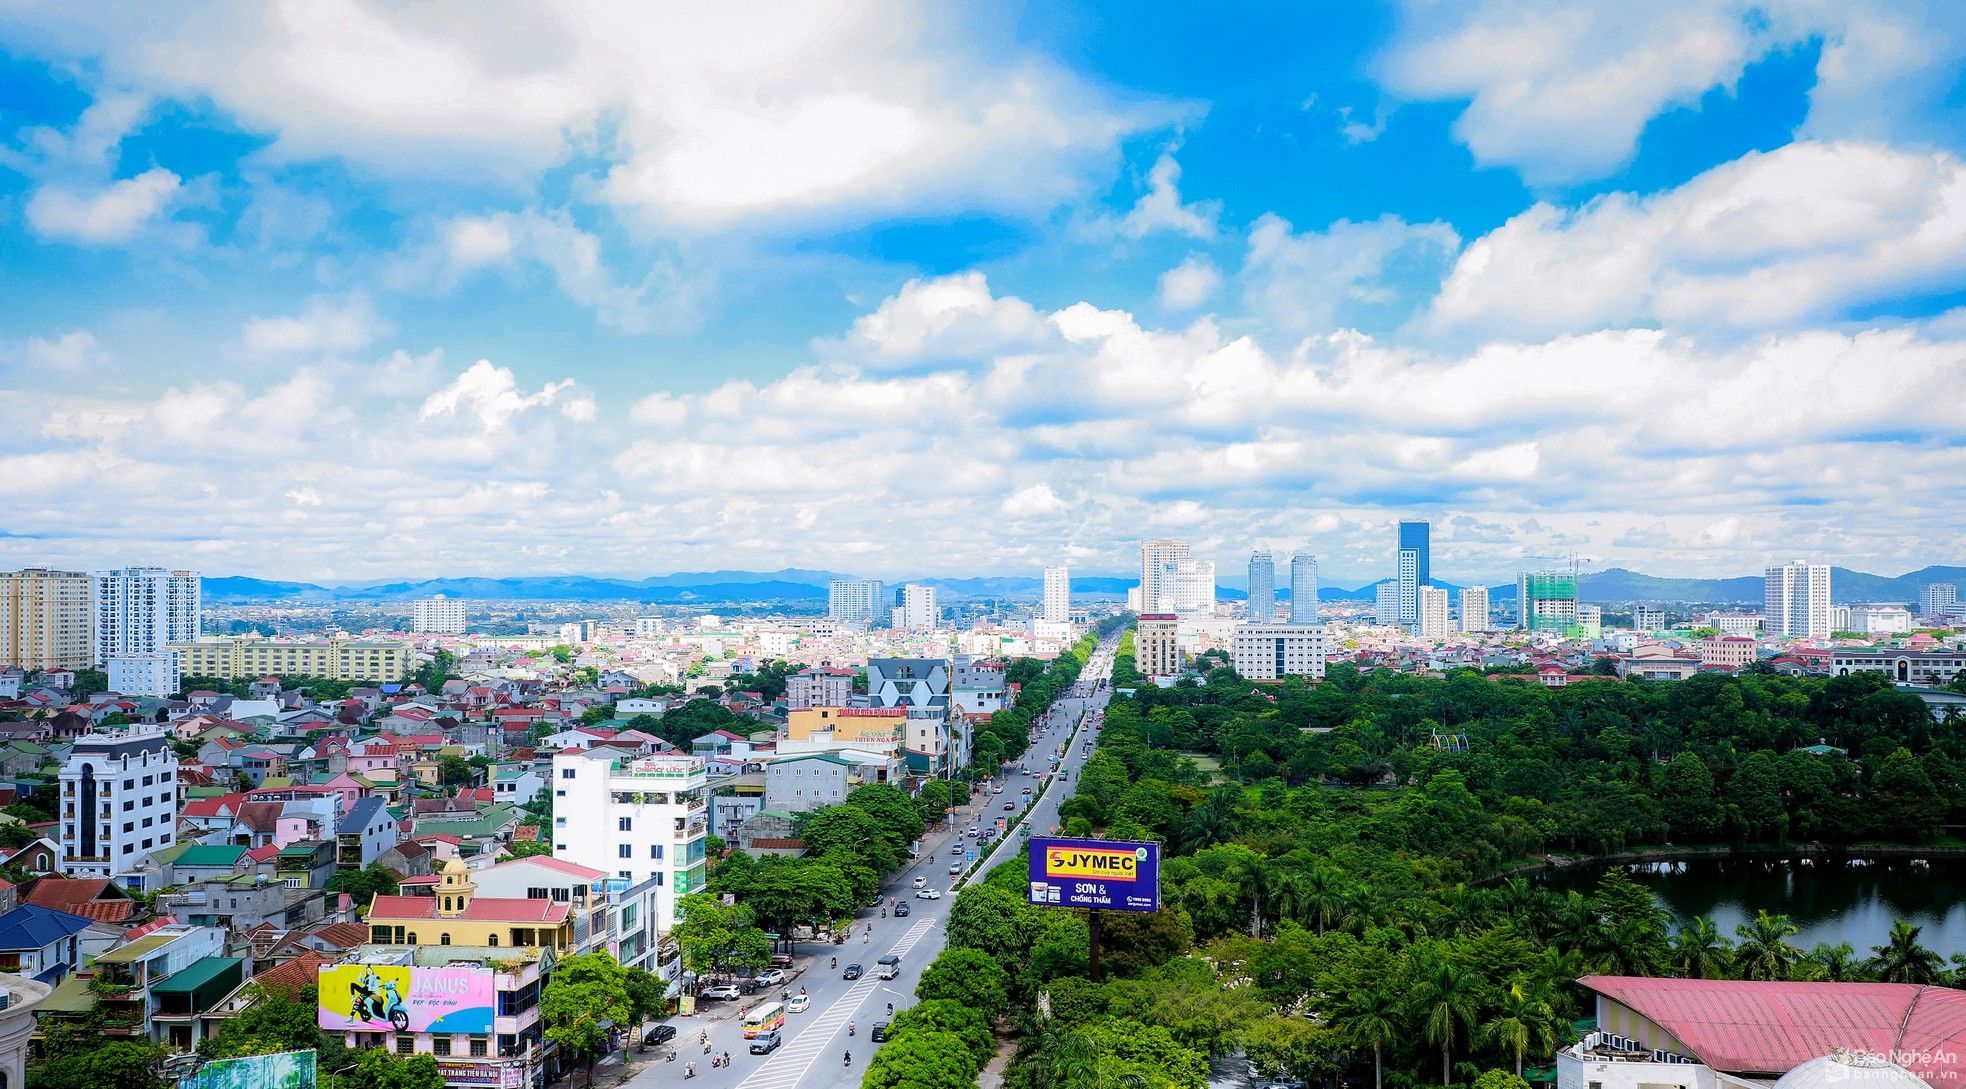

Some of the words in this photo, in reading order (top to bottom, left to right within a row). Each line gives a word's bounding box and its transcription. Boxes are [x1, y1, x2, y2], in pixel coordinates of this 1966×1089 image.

[1075, 883, 1097, 894] SƠN
[1099, 884, 1107, 895] &
[411, 976, 469, 995] JANUS
